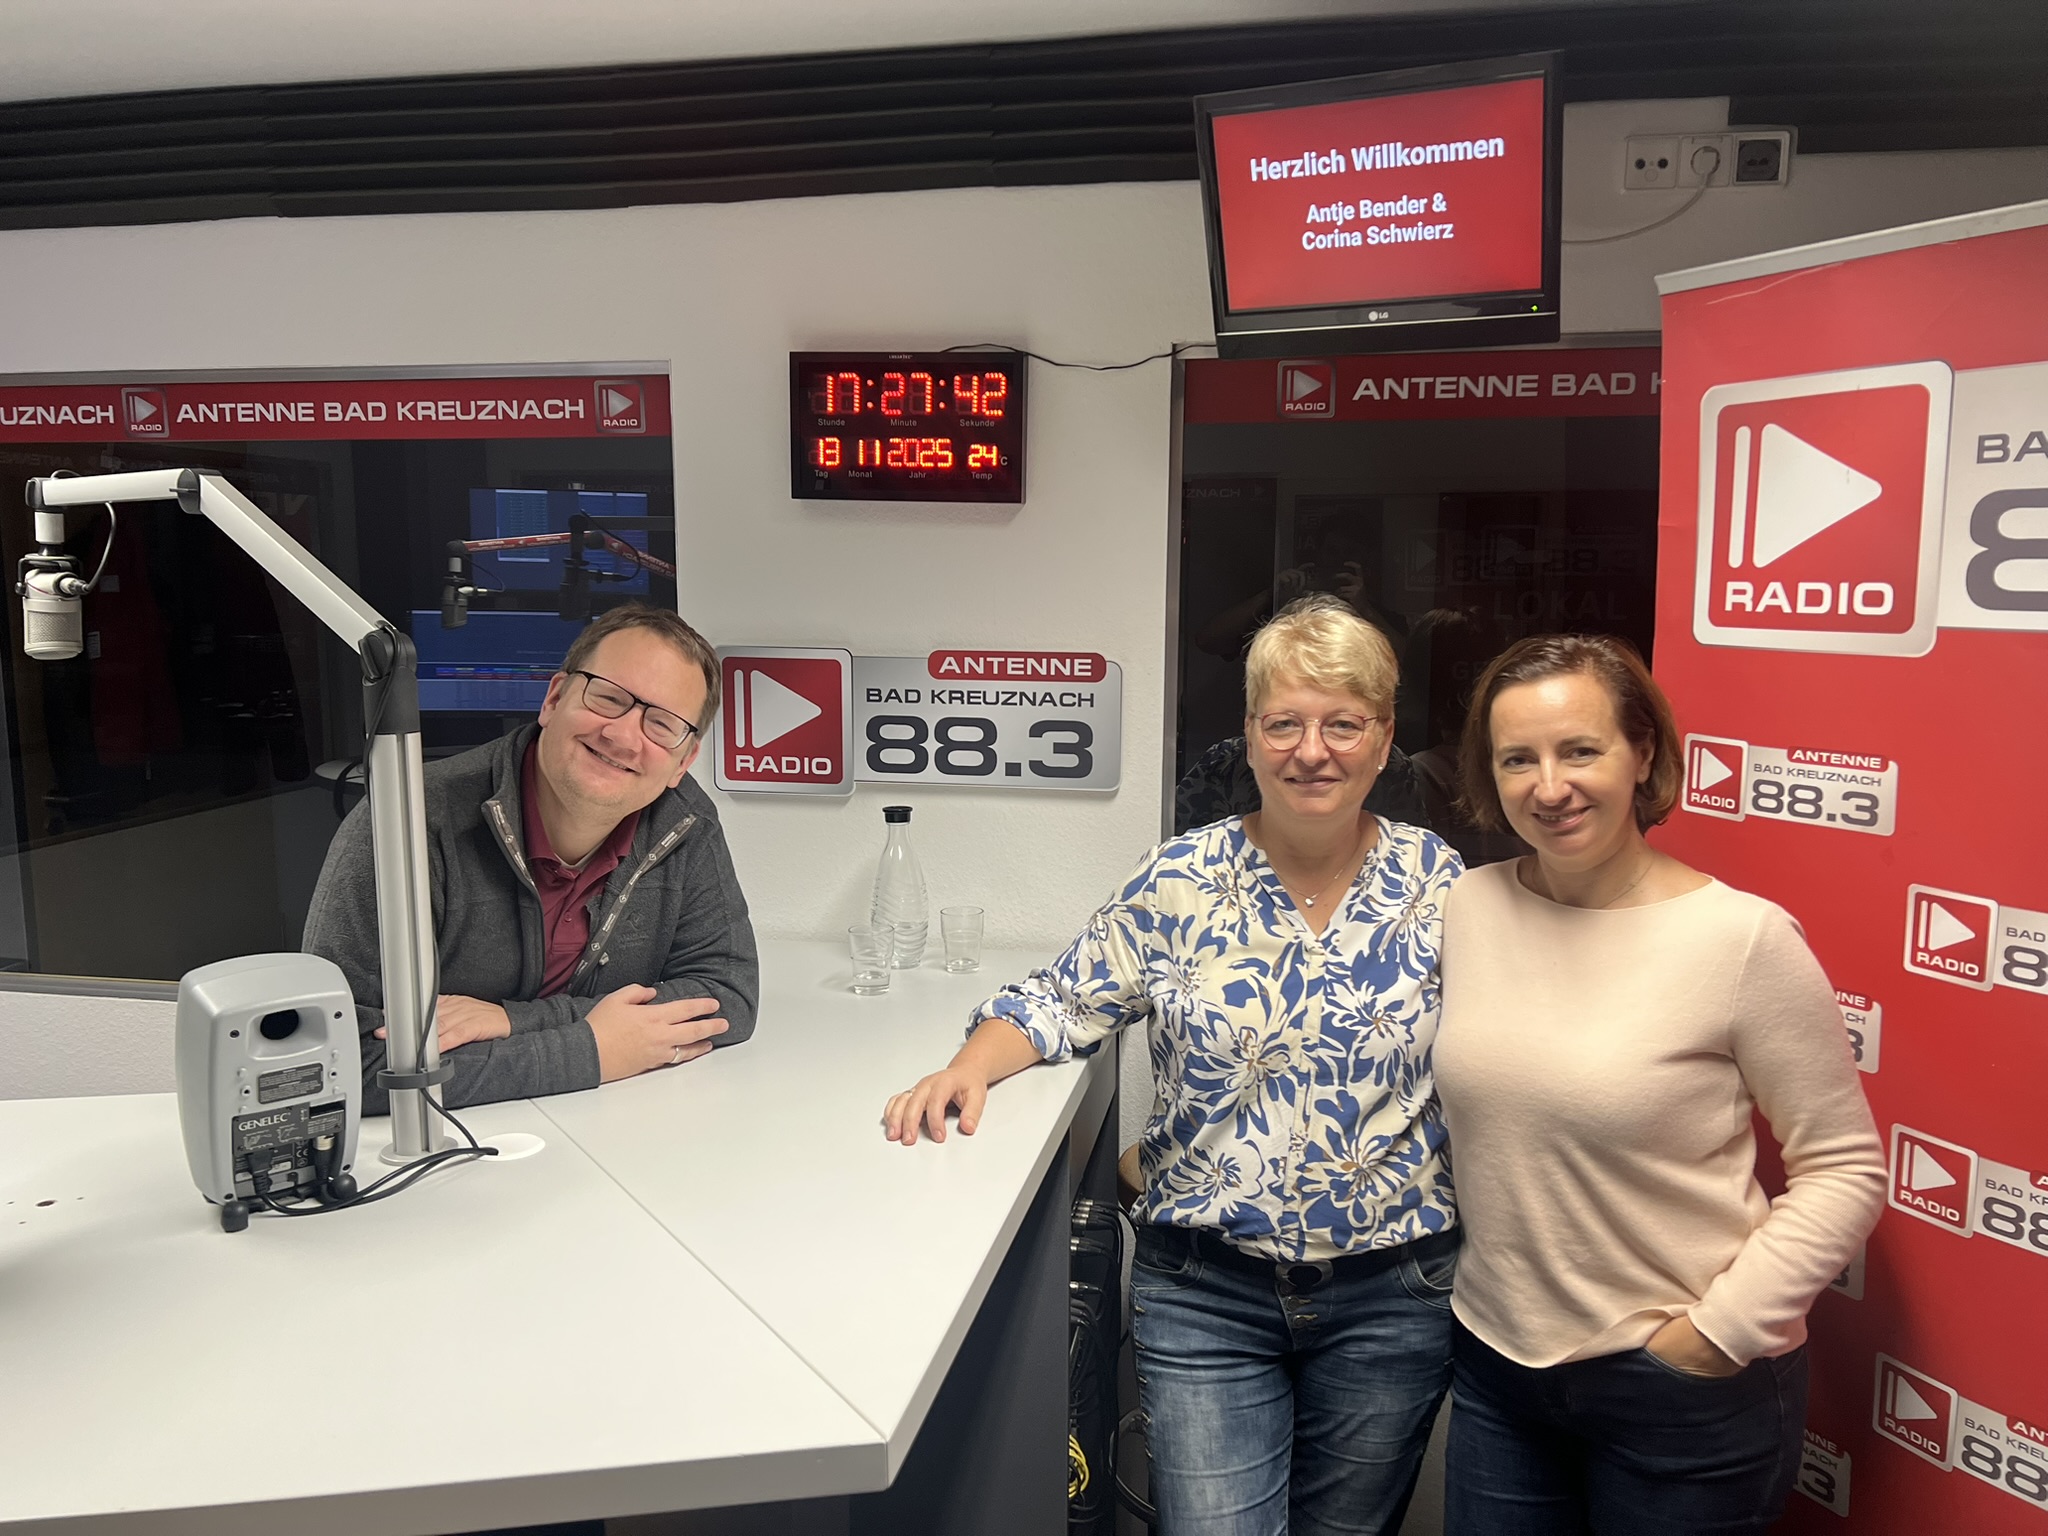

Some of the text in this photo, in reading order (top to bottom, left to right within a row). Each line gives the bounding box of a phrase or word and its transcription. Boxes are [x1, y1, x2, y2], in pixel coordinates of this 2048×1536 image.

[1250, 137, 1505, 182] Herzlich Willkommen
[1306, 192, 1447, 225] Antje Bender &
[1302, 221, 1454, 250] Corina Schwierz
[1352, 374, 1539, 401] ANTENNE
[1551, 372, 1637, 397] BAD
[176, 398, 585, 424] ANTENNE BAD KREUZNACH
[1285, 403, 1327, 411] RADIO
[131, 423, 163, 432] RADIO
[603, 418, 638, 427] RADIO
[818, 418, 996, 428] Stunde Minute Sekunde
[857, 438, 882, 466] 11
[886, 437, 954, 468] 2025
[814, 469, 993, 481] Tag Monat Jahr Temp
[1724, 581, 1895, 616] RADIO
[938, 656, 1093, 677] ANTENNE
[865, 687, 1095, 708] BAD KREUZNACH
[865, 714, 1094, 779] 88.3
[735, 754, 832, 776] RADIO
[1792, 749, 1882, 769] ANTENNE
[1753, 763, 1882, 787] BAD KREUZNACH
[1691, 792, 1736, 810] RADIO
[1751, 778, 1880, 828] 88.3
[2006, 926, 2046, 943] BAD
[1916, 952, 1980, 977] RADIO
[238, 1113, 288, 1131] GENELEC
[1985, 1179, 2024, 1199] BAD
[1900, 1189, 1961, 1223] RADIO
[1884, 1416, 1941, 1456] RADIO
[1964, 1417, 2001, 1441] BAD
